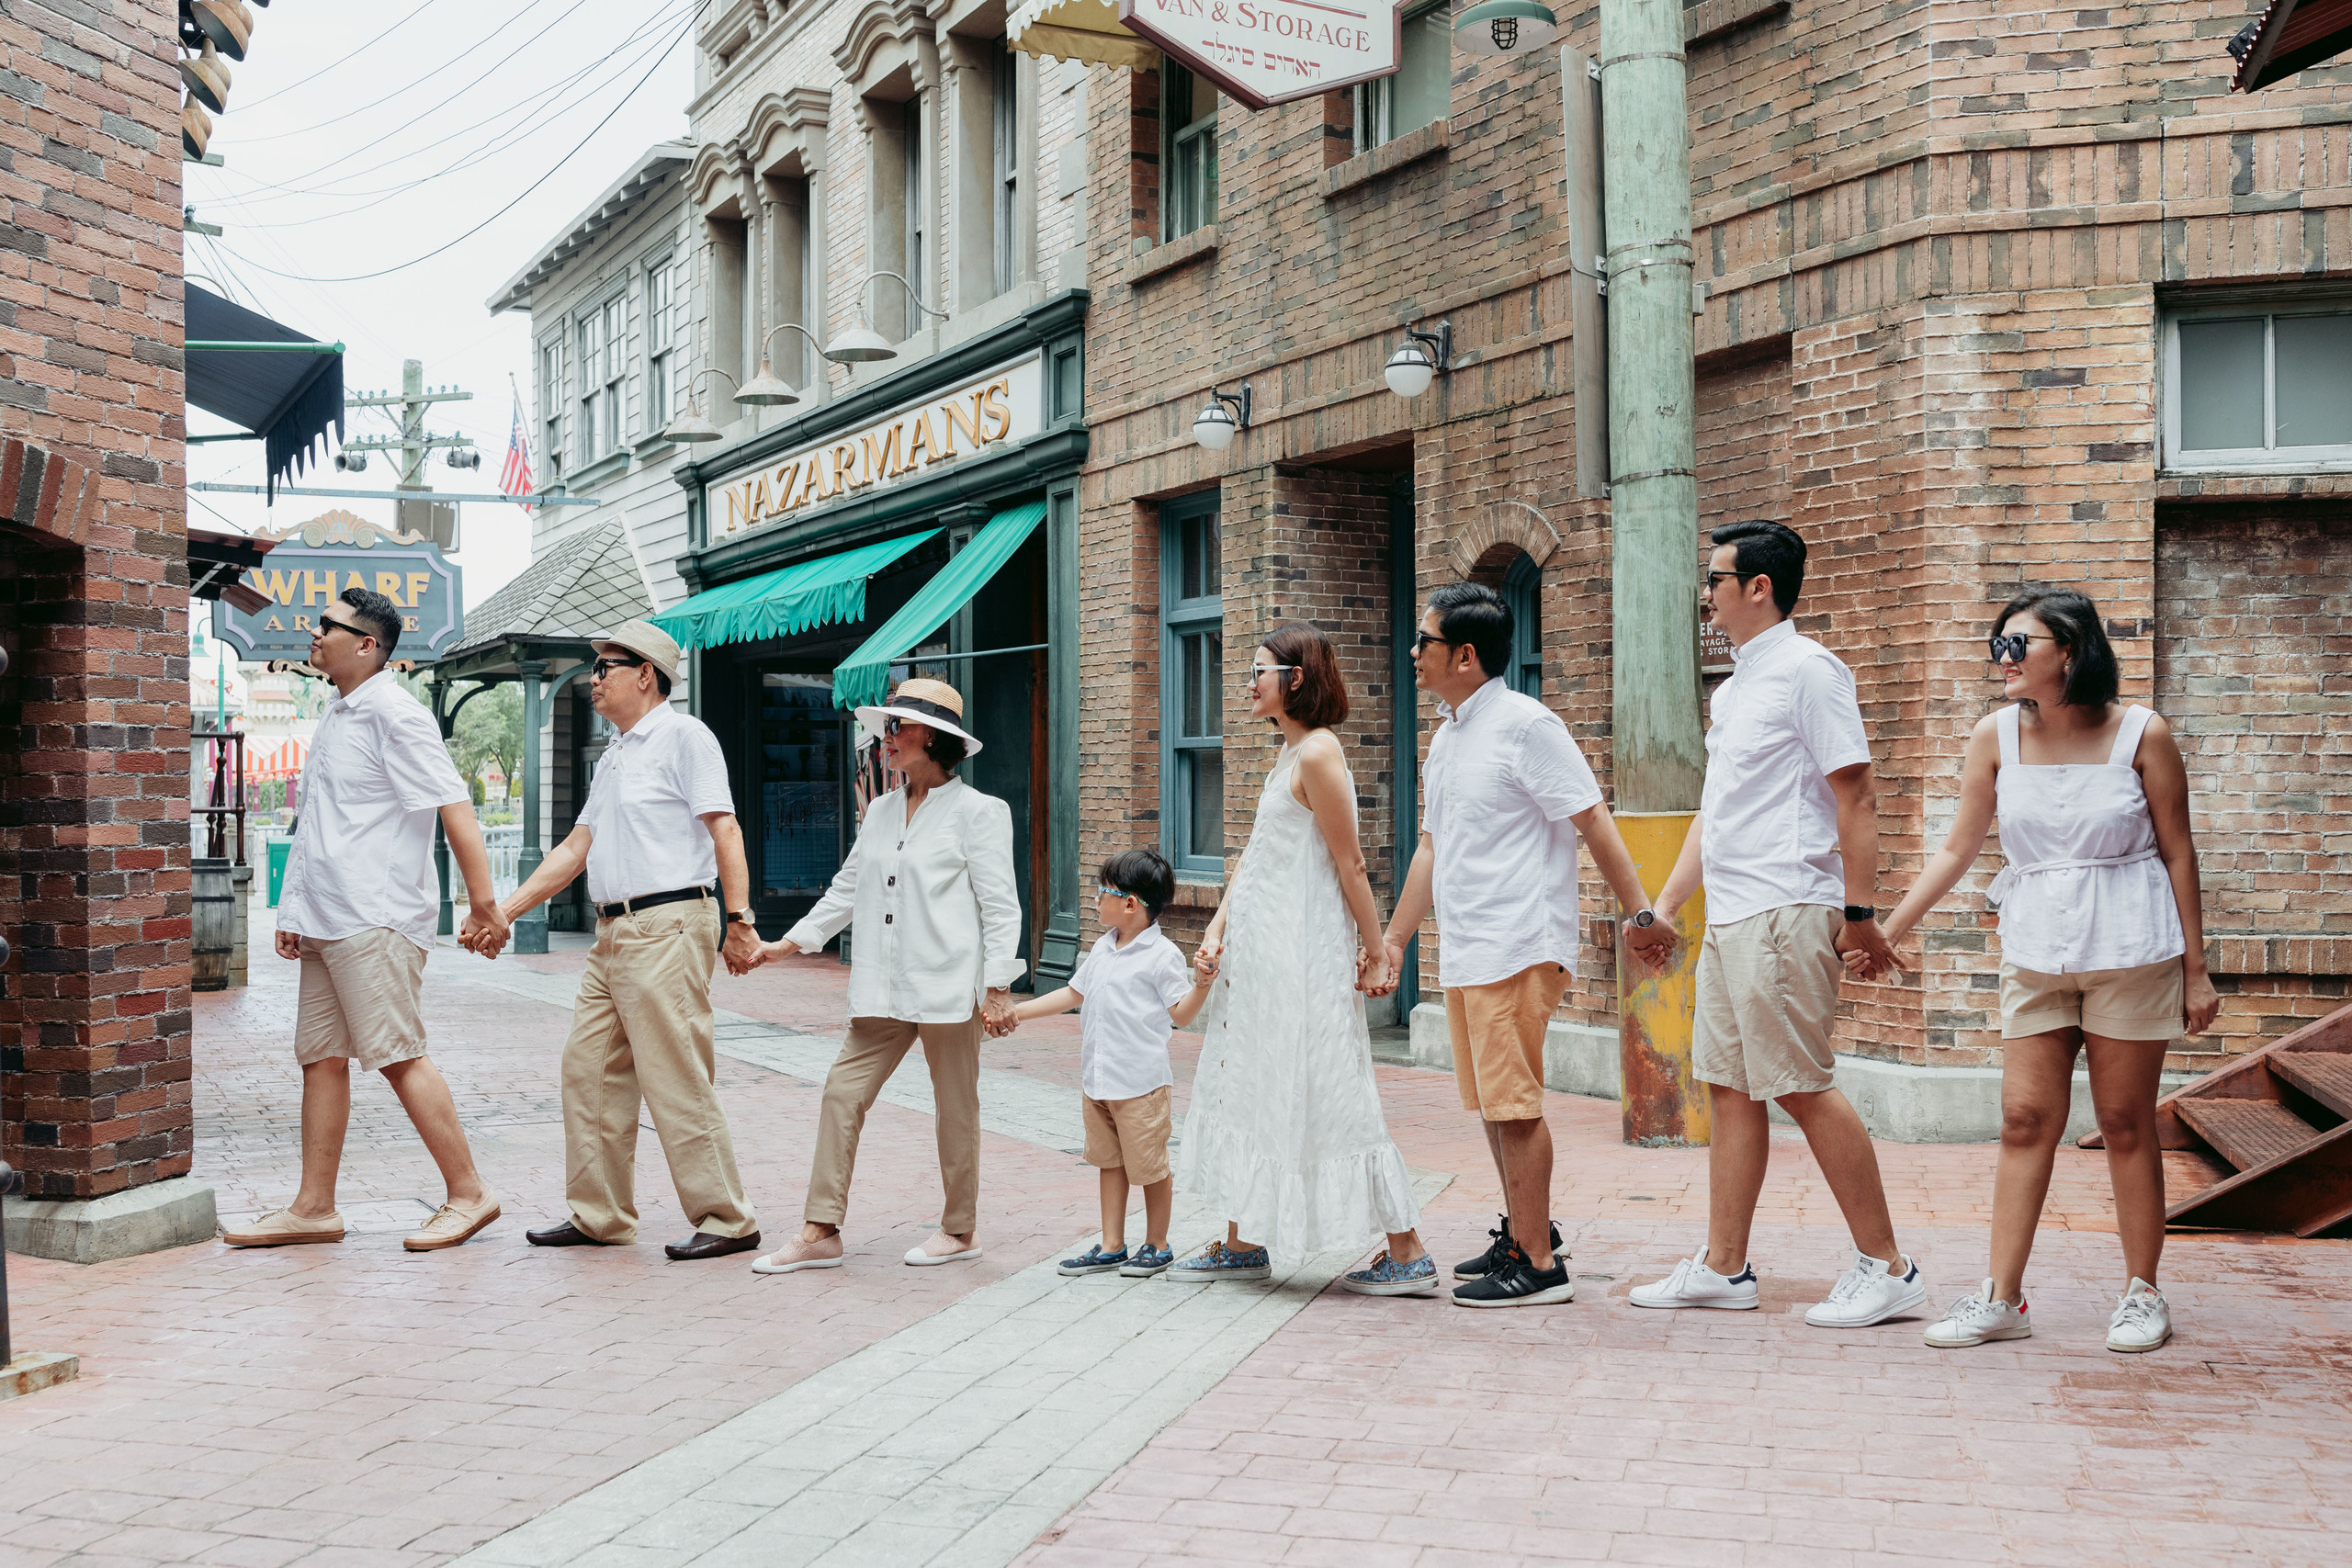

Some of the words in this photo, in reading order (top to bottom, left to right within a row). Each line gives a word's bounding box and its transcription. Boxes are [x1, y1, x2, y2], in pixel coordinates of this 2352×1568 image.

[1211, 1, 1229, 24] &
[1236, 2, 1371, 52] STORAGE
[1264, 51, 1320, 79] האחים
[725, 378, 1011, 531] NAZARMANS
[263, 615, 420, 632] ARE
